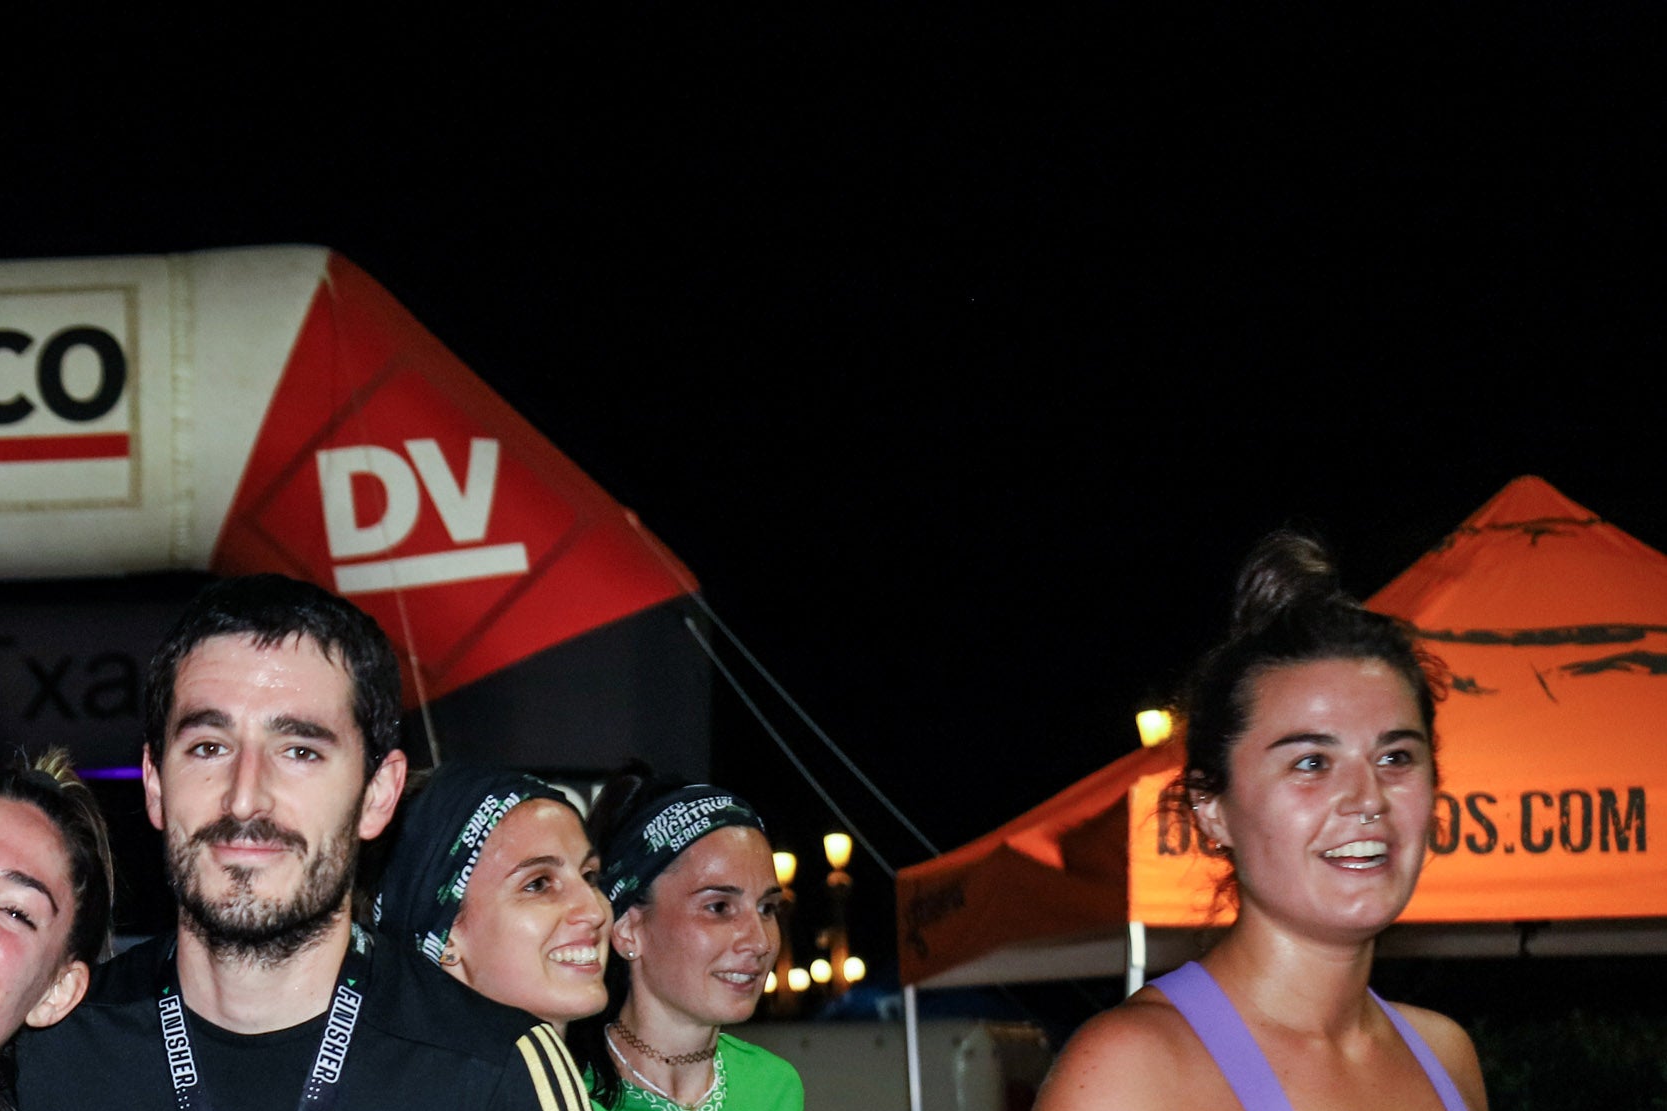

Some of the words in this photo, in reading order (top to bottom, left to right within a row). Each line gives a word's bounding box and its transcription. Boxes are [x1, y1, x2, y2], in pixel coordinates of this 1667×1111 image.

[316, 437, 500, 559] DV
[462, 794, 499, 849] SERIES
[669, 817, 711, 852] SERIES
[159, 995, 198, 1089] FINISHER
[313, 985, 363, 1083] FINISHER
